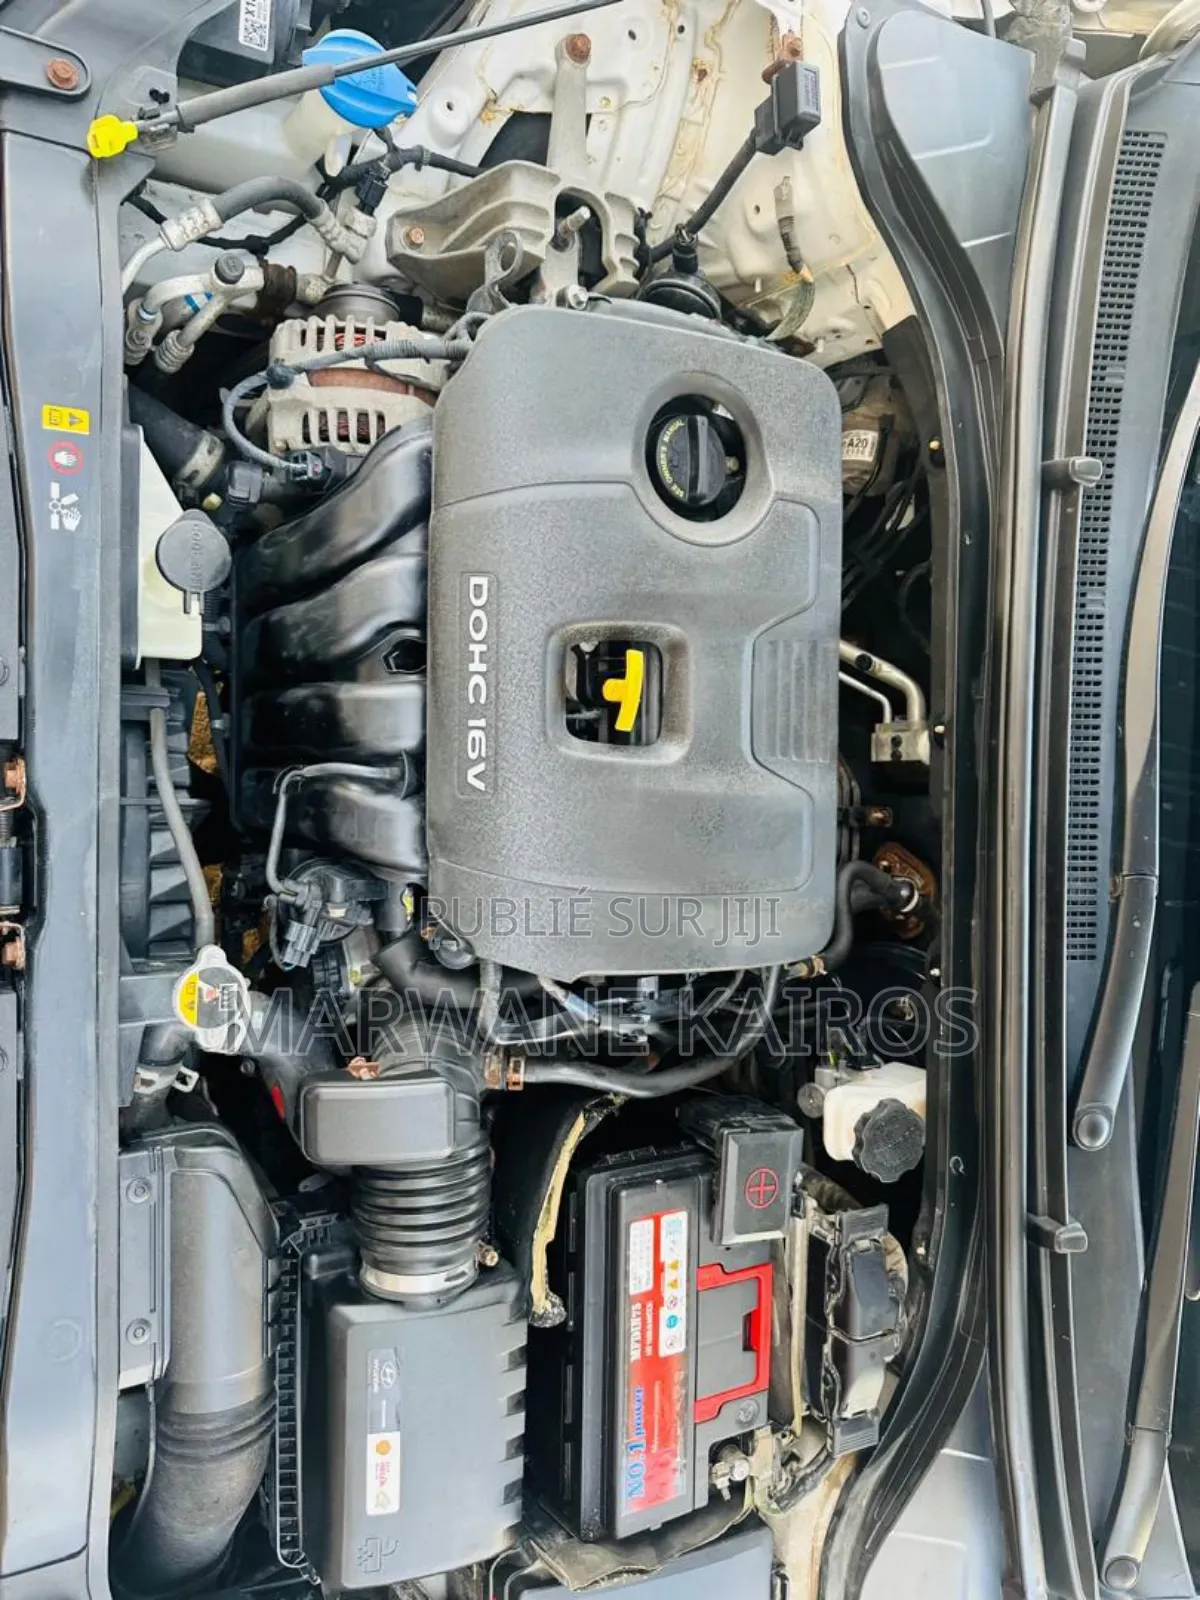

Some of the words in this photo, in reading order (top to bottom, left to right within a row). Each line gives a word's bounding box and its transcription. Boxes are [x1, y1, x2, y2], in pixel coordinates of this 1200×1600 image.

[663, 419, 686, 443] MANUAL
[467, 575, 489, 705] DOHC
[466, 717, 488, 792] 16V
